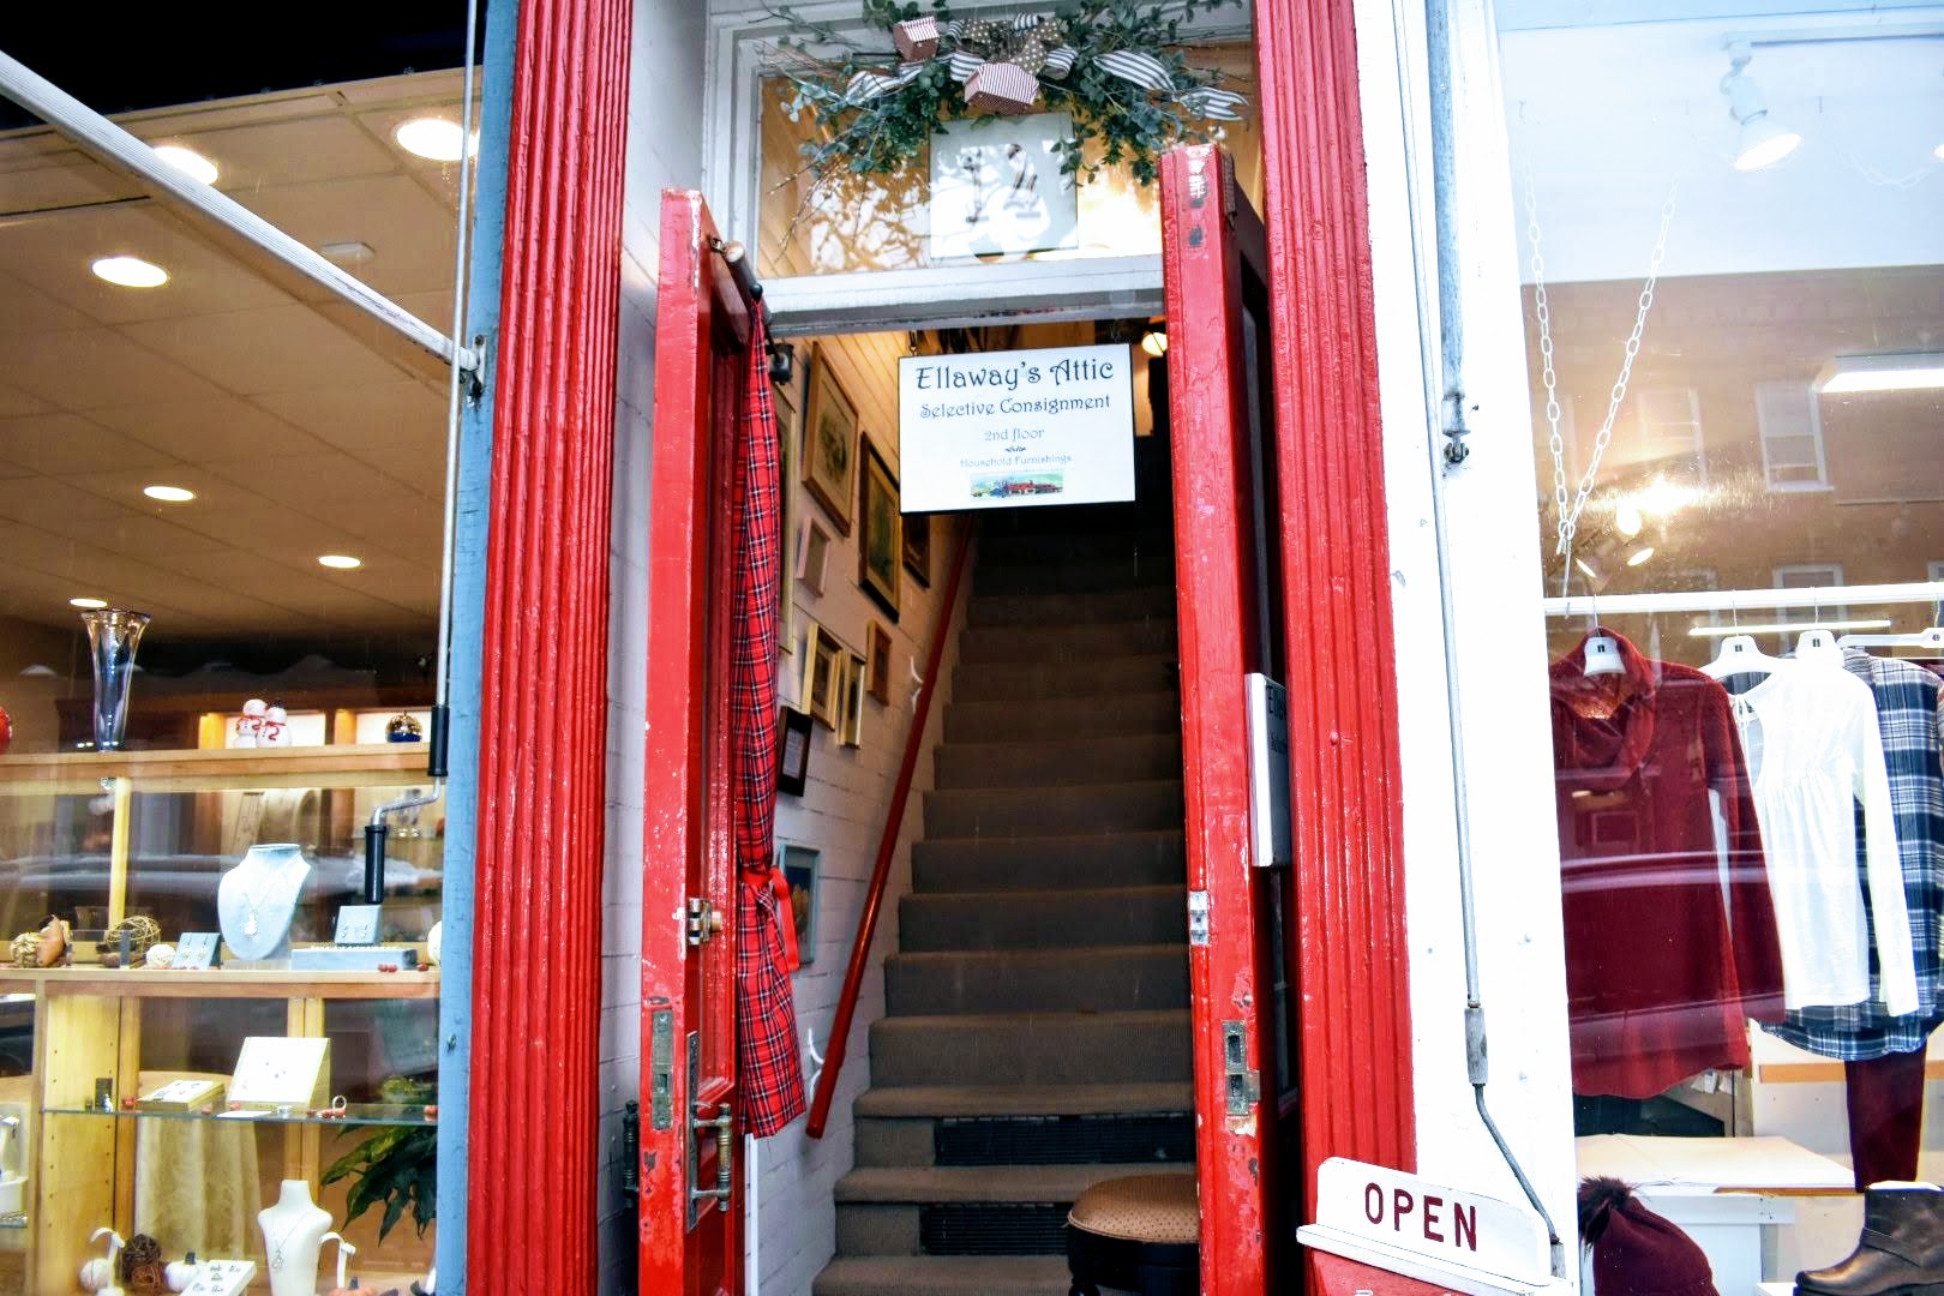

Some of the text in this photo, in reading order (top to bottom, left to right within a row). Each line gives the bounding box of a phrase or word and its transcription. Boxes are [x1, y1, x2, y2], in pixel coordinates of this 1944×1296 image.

[916, 358, 1114, 390] Ellaway's Attic
[920, 395, 1110, 419] Selective Consignment
[984, 427, 1044, 441] 2nd floor
[960, 454, 1072, 467] Household Furnishings
[1365, 1182, 1477, 1251] OPEN
